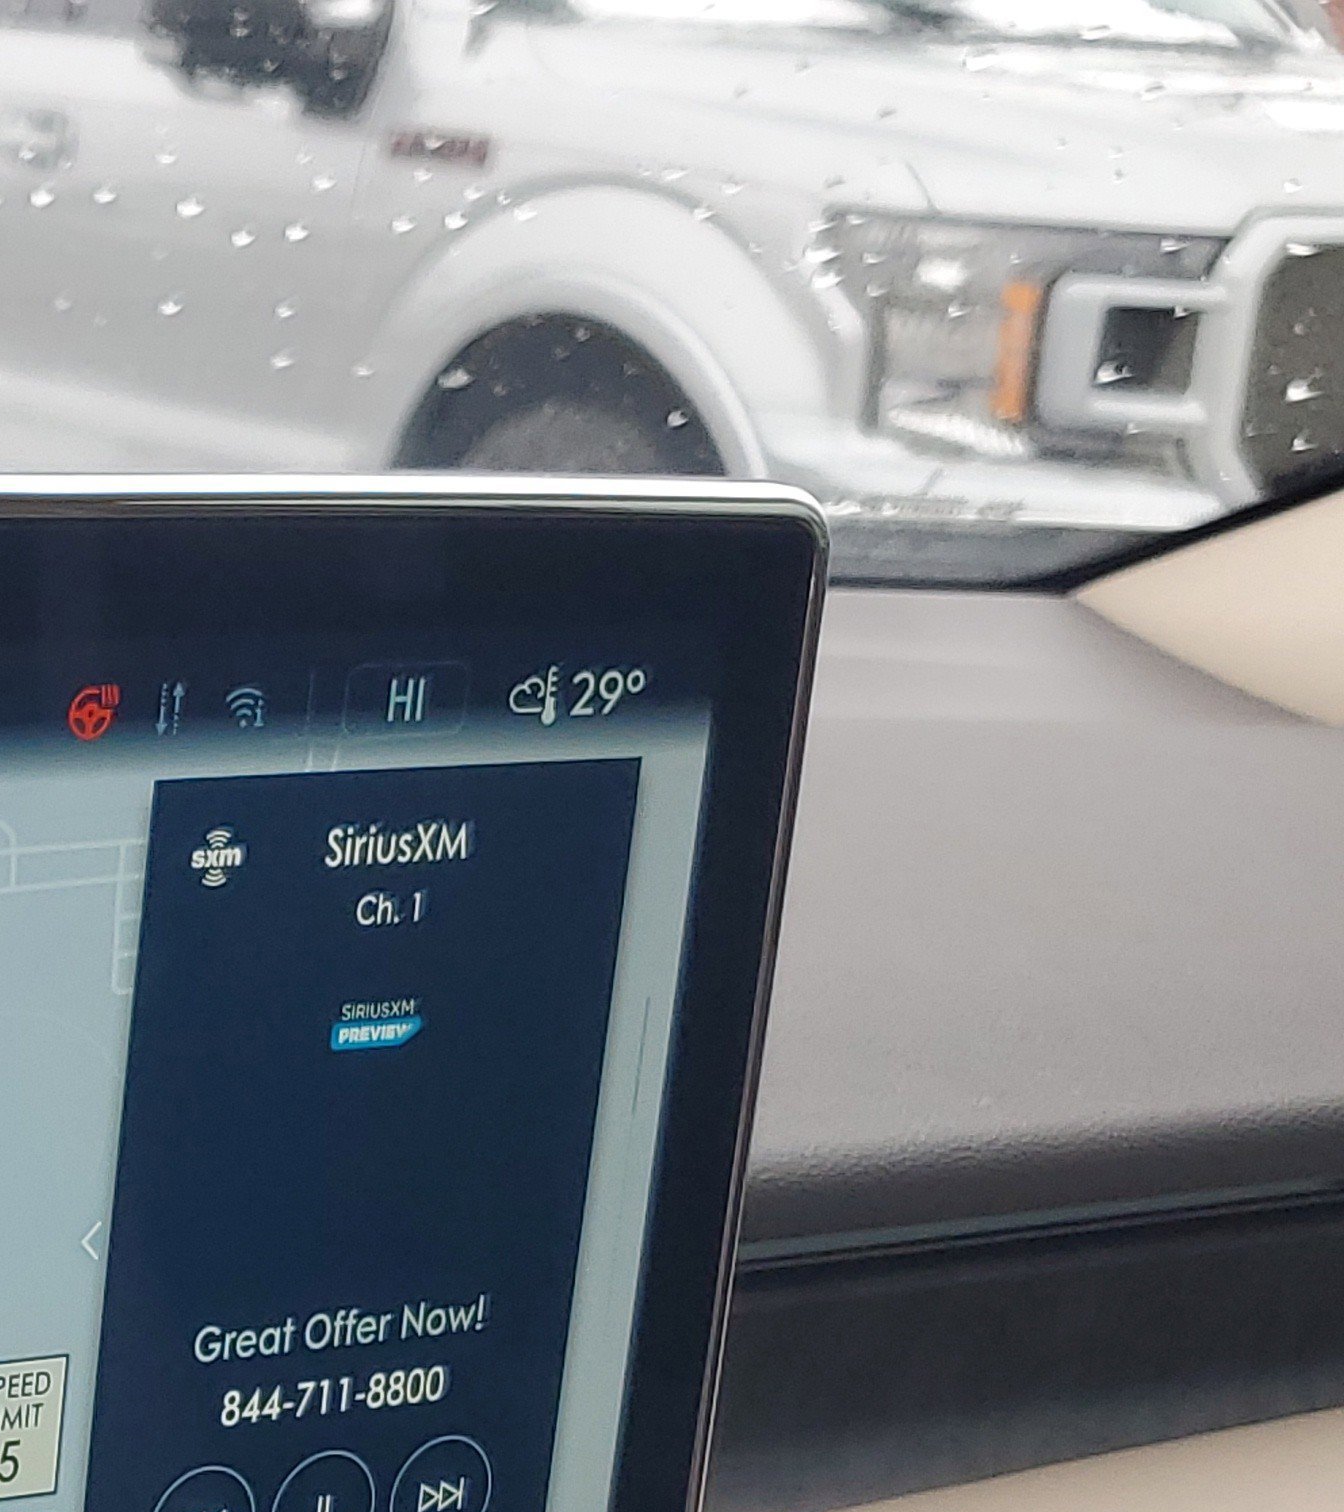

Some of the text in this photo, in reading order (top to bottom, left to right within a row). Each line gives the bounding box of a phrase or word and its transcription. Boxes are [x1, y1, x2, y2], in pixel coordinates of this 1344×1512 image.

[387, 676, 425, 721] HI
[191, 847, 242, 868] sxm
[325, 821, 468, 868] SiriusXM
[356, 892, 423, 926] Ch. 1
[341, 999, 415, 1021] SIRIUSXM
[338, 1023, 413, 1044] PREVIEW
[194, 1295, 487, 1363] Great Offer Now!
[220, 1366, 446, 1427] 844-711-8800
